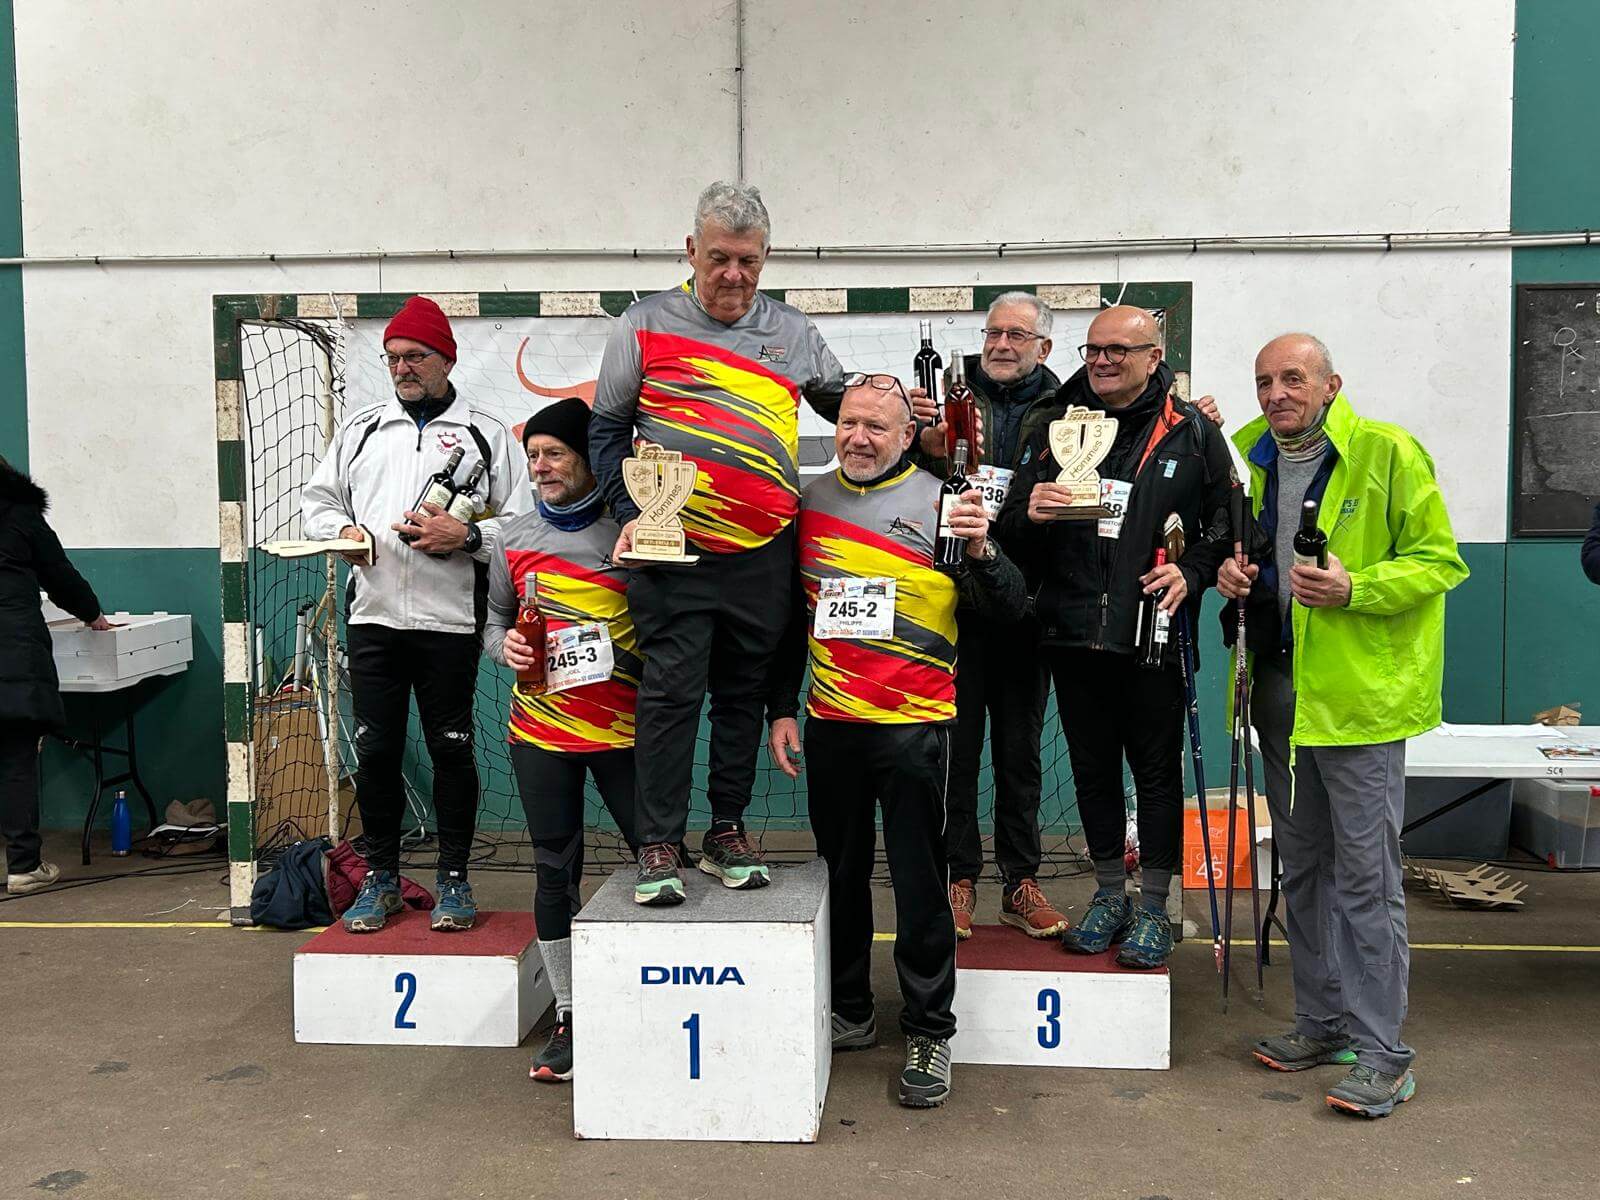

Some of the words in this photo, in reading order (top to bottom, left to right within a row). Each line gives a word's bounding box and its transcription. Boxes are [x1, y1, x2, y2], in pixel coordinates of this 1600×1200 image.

[1069, 440, 1103, 478] Hommes
[648, 483, 683, 522] Hommes
[828, 601, 878, 618] 245-2
[547, 646, 598, 672] 245-3
[640, 966, 746, 985] DIMA
[394, 972, 417, 1029] 2
[1037, 988, 1061, 1049] 3
[682, 1013, 700, 1080] 1
